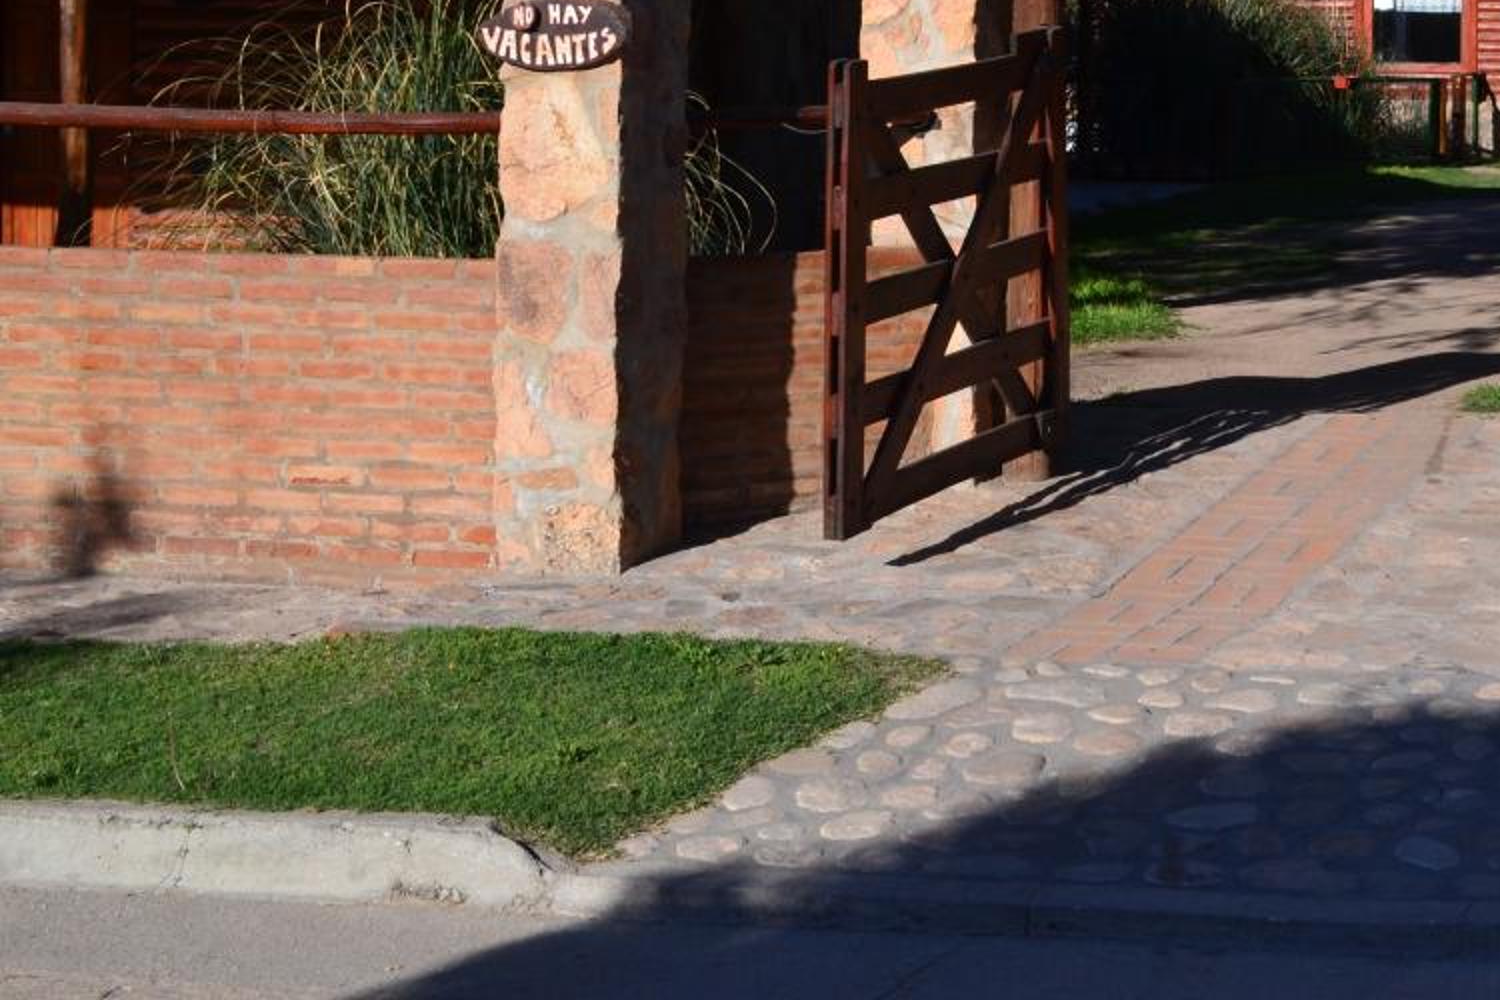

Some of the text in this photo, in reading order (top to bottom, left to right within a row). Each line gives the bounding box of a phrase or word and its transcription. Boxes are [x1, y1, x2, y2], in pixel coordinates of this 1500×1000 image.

[513, 3, 592, 26] NO HAY
[481, 26, 617, 65] VACANTES
